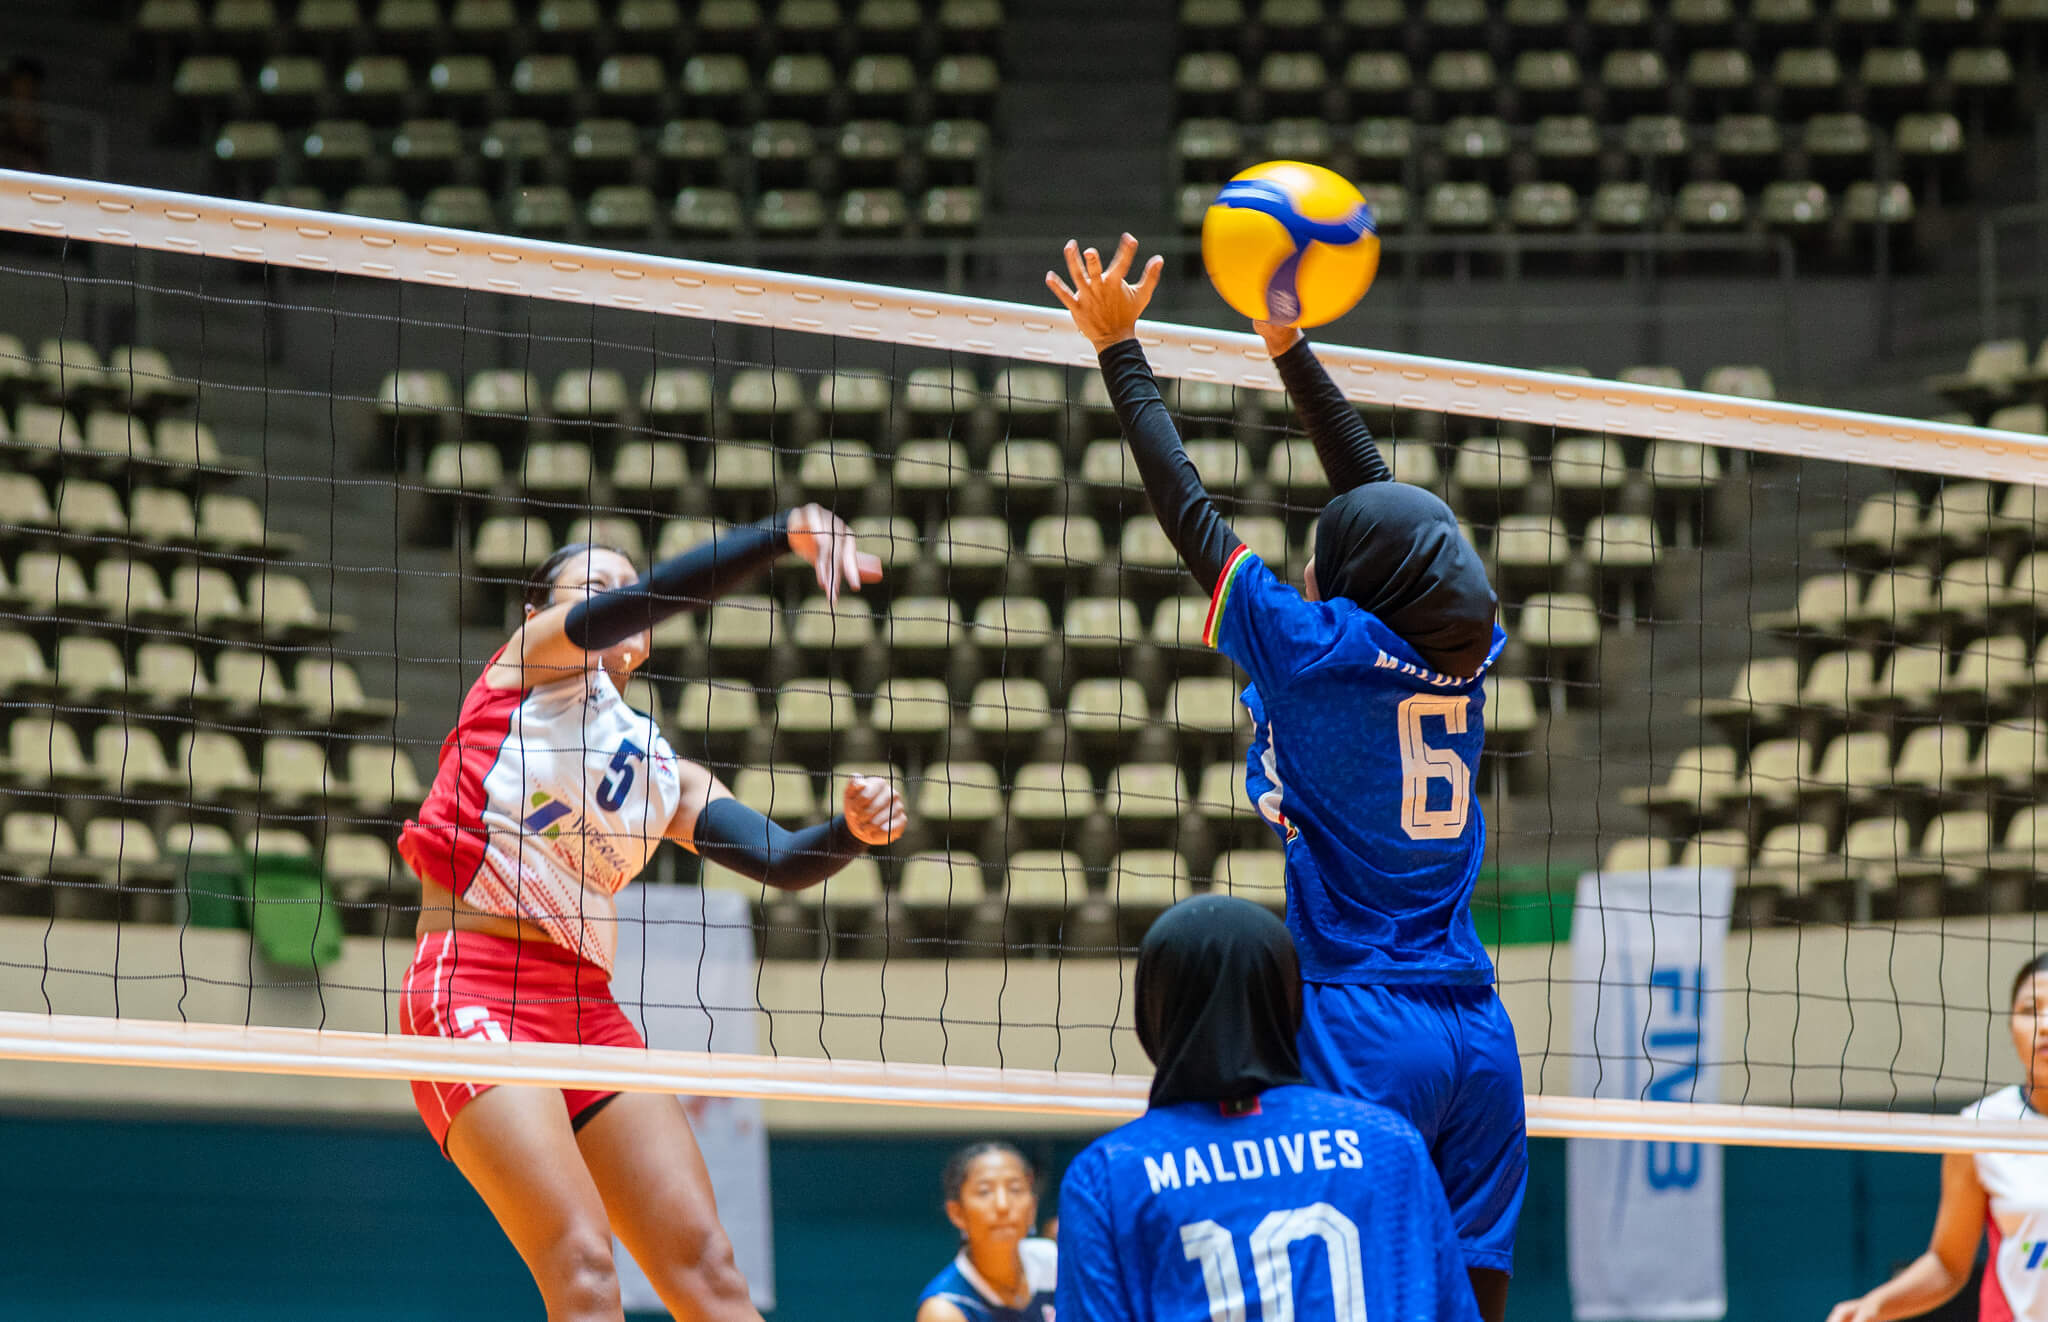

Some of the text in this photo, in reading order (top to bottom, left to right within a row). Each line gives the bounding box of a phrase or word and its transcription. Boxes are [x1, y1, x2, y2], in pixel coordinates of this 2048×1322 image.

[596, 738, 646, 812] 5
[1397, 692, 1471, 840] 6
[1648, 967, 1706, 1191] FIVB
[1144, 1129, 1364, 1195] MALDIVES
[1179, 1201, 1368, 1322] 10
